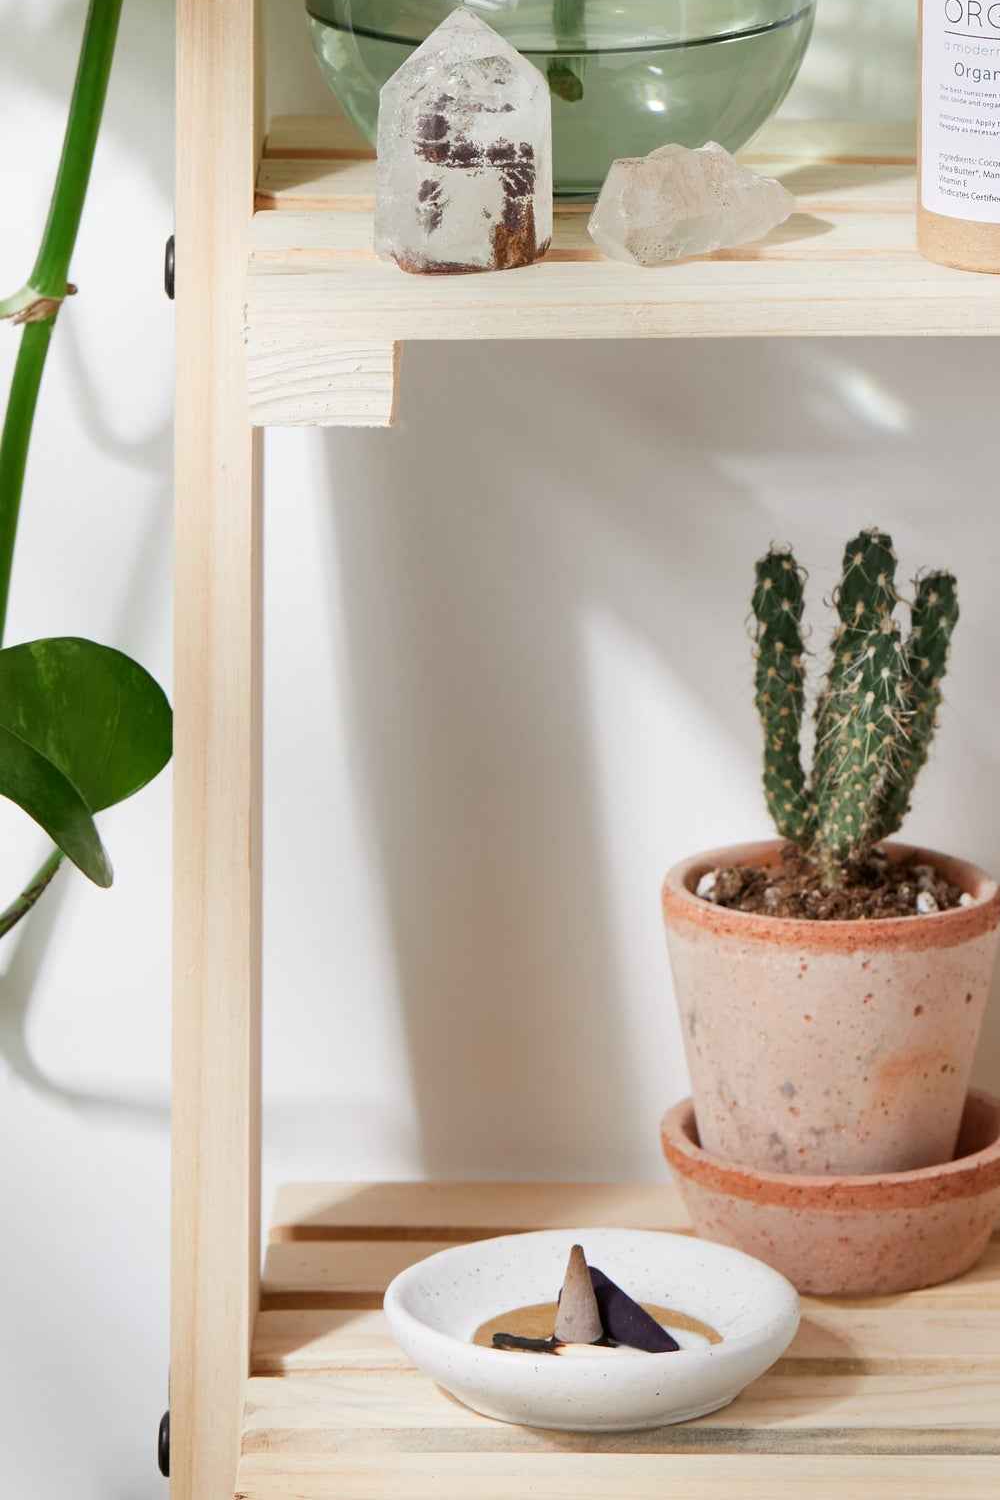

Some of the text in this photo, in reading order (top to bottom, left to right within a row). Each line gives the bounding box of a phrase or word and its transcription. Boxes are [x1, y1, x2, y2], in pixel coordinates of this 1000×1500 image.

[943, 42, 951, 52] a
[964, 90, 997, 99] sunscreen
[939, 113, 973, 125] ctions:
[975, 118, 996, 128] Apply
